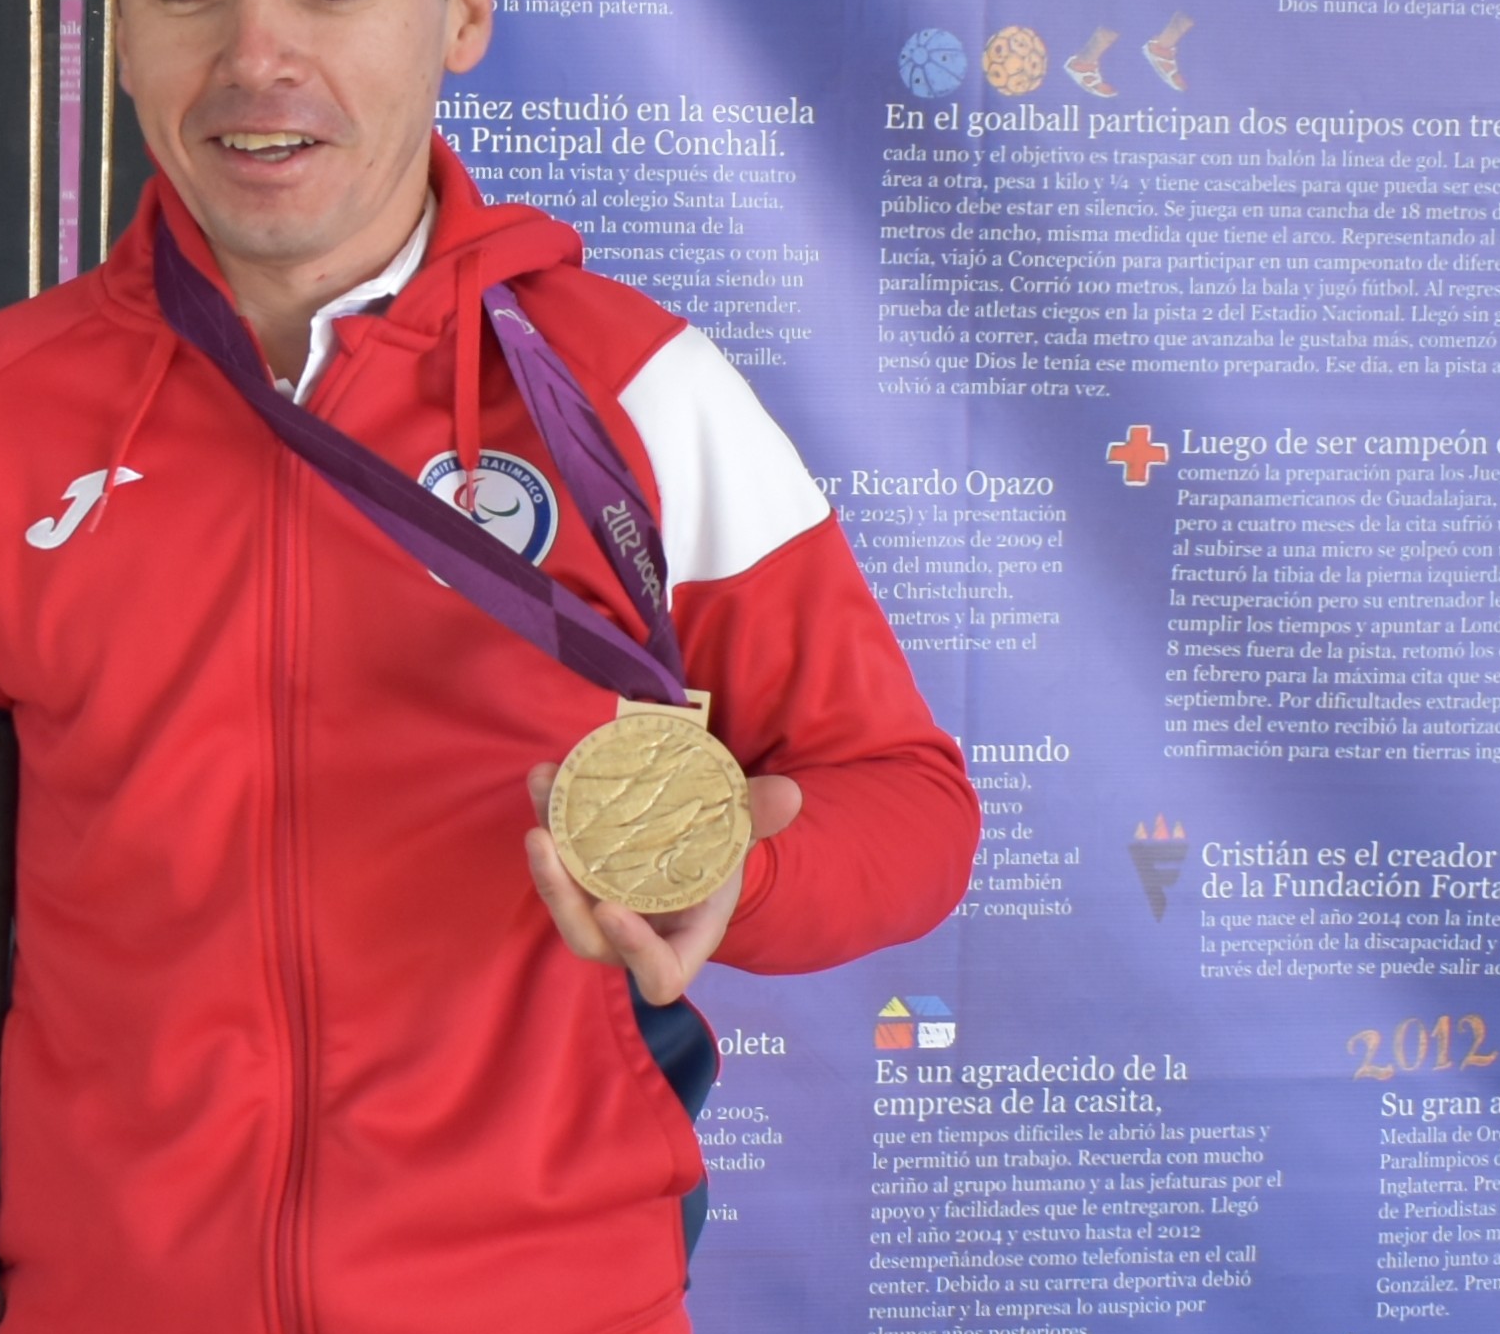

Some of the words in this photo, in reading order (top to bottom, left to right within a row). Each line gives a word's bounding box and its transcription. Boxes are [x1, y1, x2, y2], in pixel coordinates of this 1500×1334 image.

[435, 91, 513, 120] niñez
[521, 93, 628, 121] estudió
[637, 103, 670, 122] en
[679, 95, 703, 122] la
[712, 96, 815, 125] escuela
[884, 103, 925, 130] En
[933, 102, 959, 131] el
[966, 103, 1079, 138] goalball
[1088, 106, 1230, 141] participan
[1239, 107, 1287, 135] dos
[1295, 109, 1404, 143] equipos
[1412, 118, 1461, 137] con
[471, 125, 602, 161] Principal
[611, 126, 646, 155] de
[654, 128, 785, 156] Conchalí.
[1181, 428, 1268, 462] Luego
[1275, 427, 1308, 455] de
[1315, 436, 1358, 455] ser
[1364, 428, 1488, 462] campeón
[477, 458, 544, 504] RALÍMPICO
[850, 468, 958, 496] Ricardo
[965, 469, 1054, 503] Opazo
[1346, 1014, 1499, 1081] 2012
[875, 1059, 908, 1084] Es
[917, 1065, 953, 1084] un
[961, 1055, 1115, 1089] agradecido
[1123, 1054, 1156, 1081] de
[1164, 1054, 1188, 1081] la
[873, 1086, 993, 1122] empresa
[1000, 1087, 1034, 1115] de
[1042, 1087, 1067, 1114] la
[1074, 1086, 1162, 1114] casita,
[1381, 1092, 1414, 1117] Su
[1421, 1097, 1481, 1123] gran
